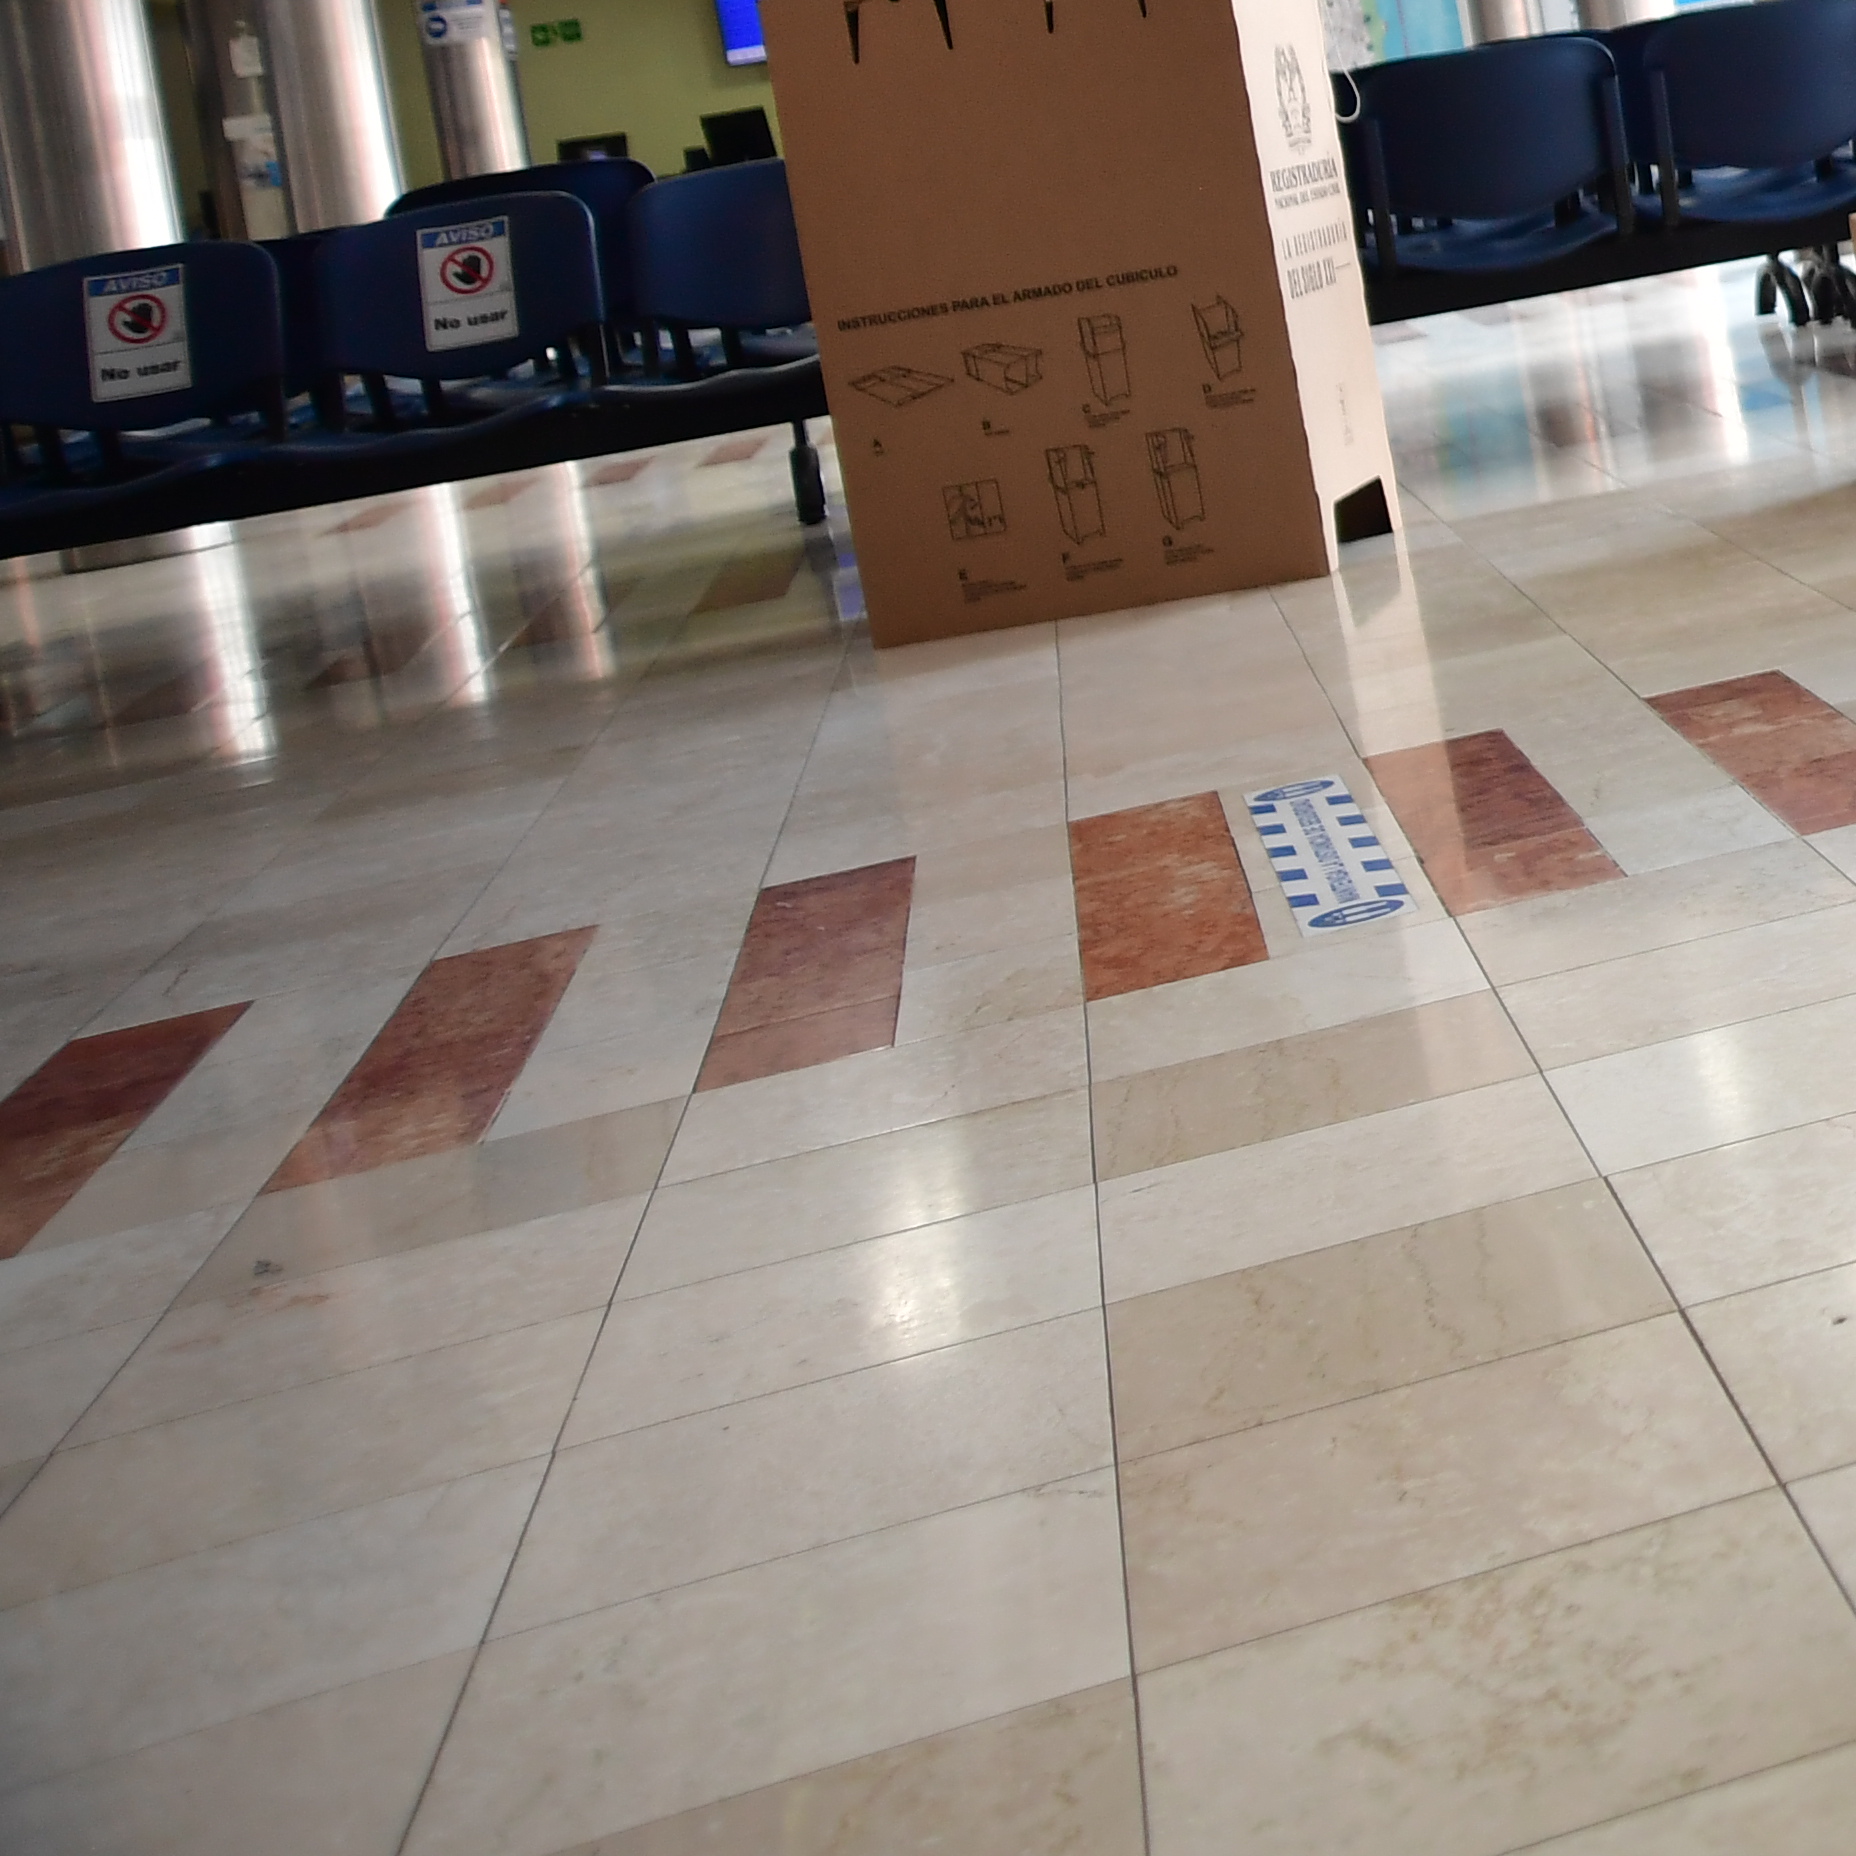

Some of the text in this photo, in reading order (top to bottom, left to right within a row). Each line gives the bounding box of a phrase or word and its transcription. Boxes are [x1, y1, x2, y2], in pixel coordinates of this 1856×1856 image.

[435, 223, 494, 246] AVISO
[105, 271, 168, 293] AVISO
[838, 264, 1179, 332] INSTRUCCIONES PARA EL ARMADO DEL CUBICULO
[434, 310, 508, 331] No usar
[101, 360, 181, 382] No usar
